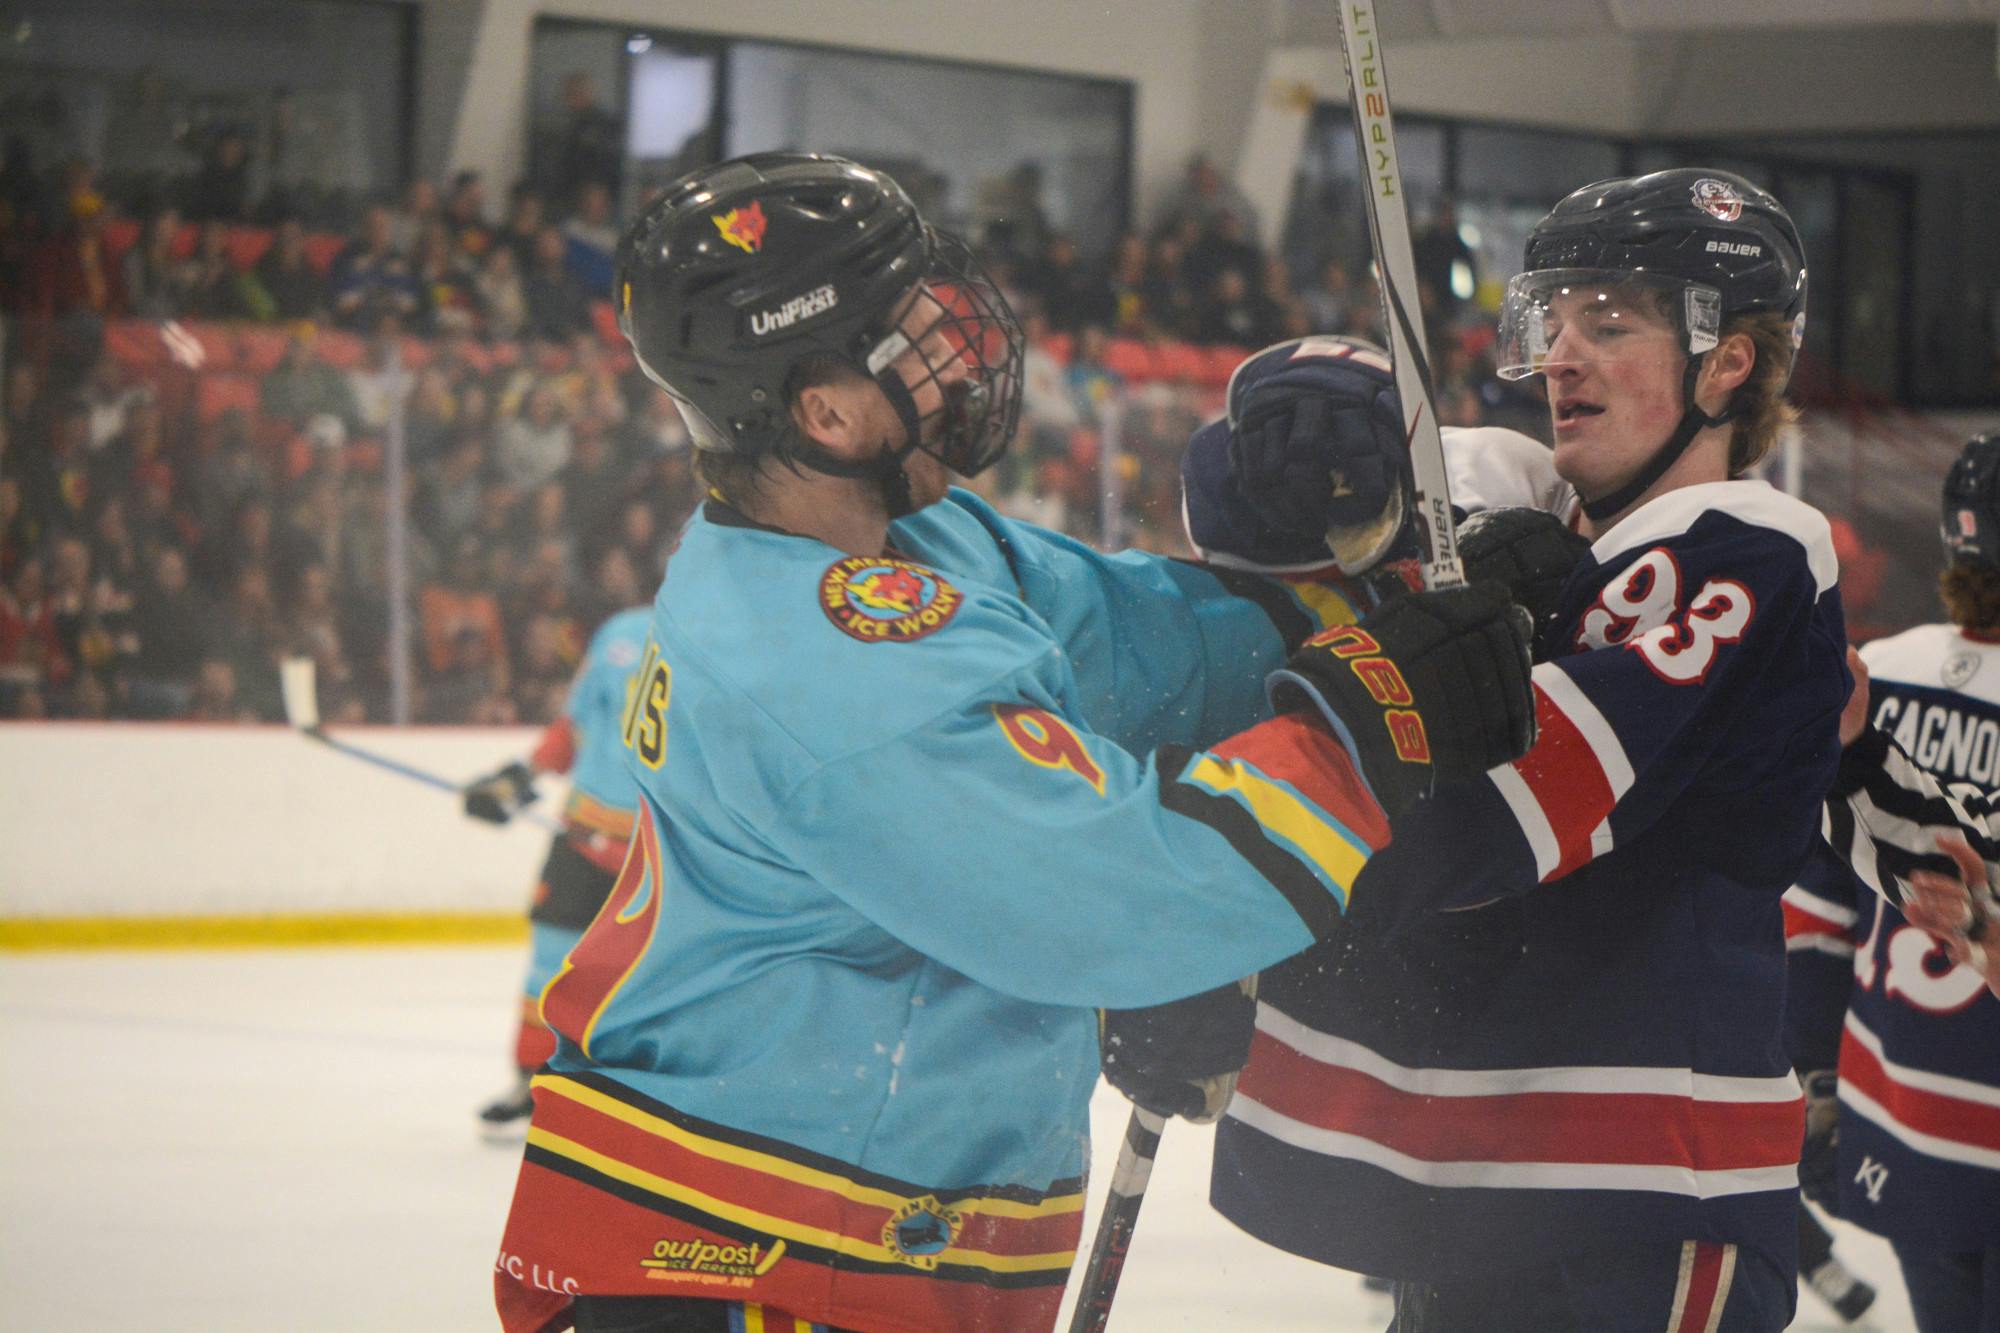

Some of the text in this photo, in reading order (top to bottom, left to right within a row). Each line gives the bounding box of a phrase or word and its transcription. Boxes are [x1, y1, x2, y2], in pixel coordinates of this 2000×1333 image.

[1705, 240, 1761, 257] BAUER
[751, 285, 837, 335] UniFirst
[825, 566, 849, 608] NEW
[847, 613, 890, 636] ICE
[1576, 546, 1756, 686] 93
[991, 704, 1105, 797] 9
[653, 1239, 760, 1269] outpost
[532, 1264, 581, 1296] LLC
